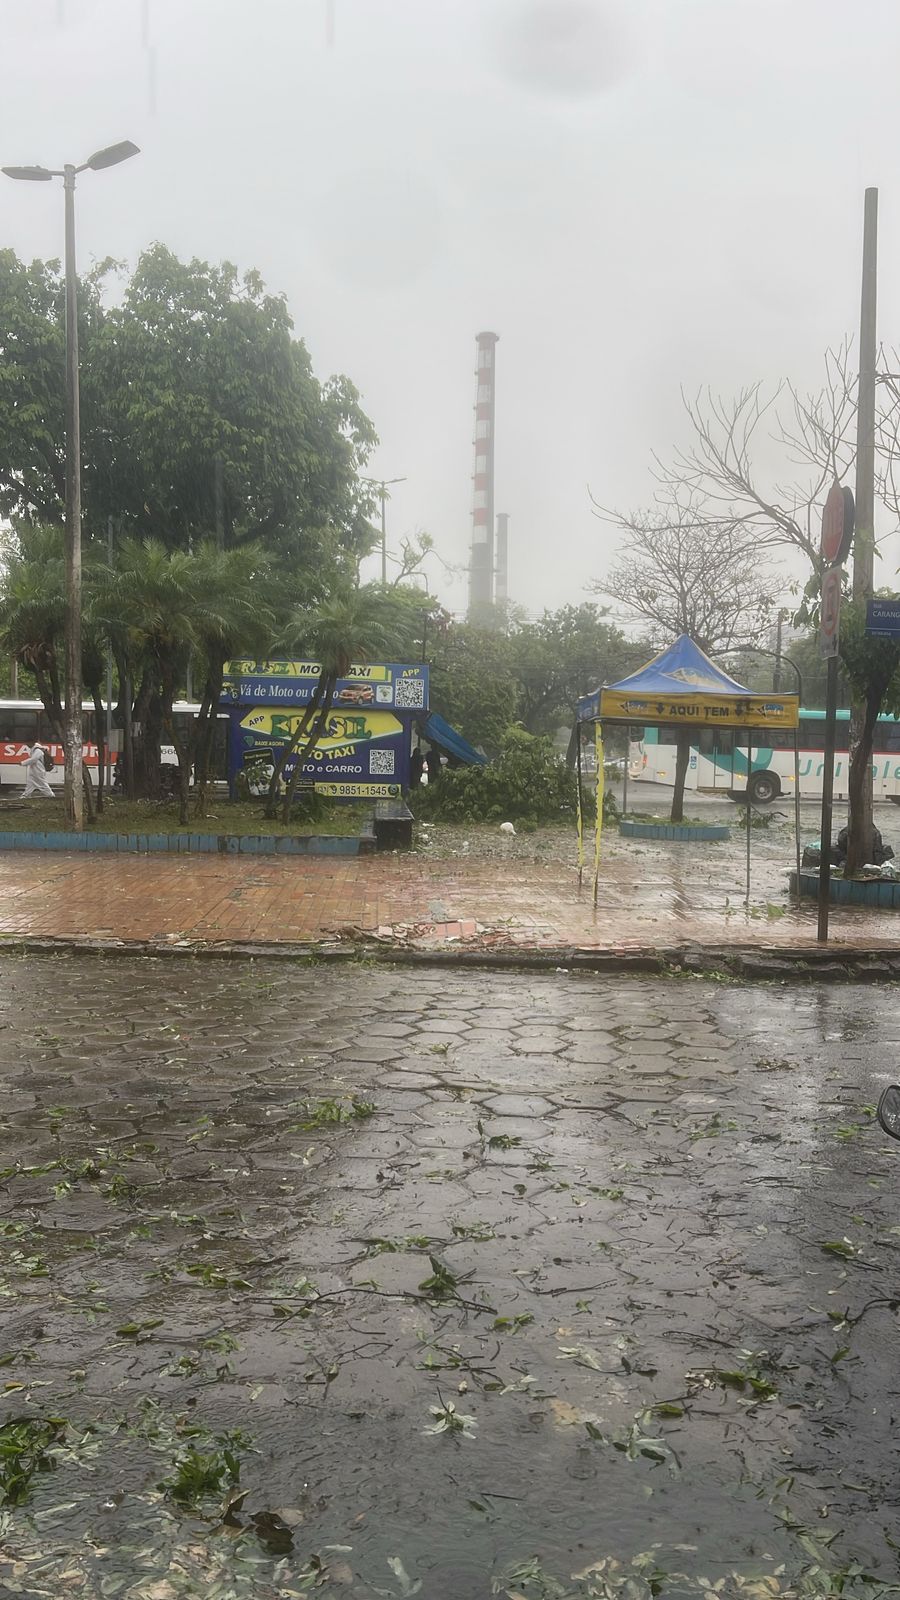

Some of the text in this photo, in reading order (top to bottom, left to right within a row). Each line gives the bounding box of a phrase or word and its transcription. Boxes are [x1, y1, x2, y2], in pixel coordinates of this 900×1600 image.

[299, 665, 321, 674] MO
[347, 667, 371, 677] AXI
[402, 668, 420, 677] APP
[240, 684, 252, 696] Vá
[254, 684, 266, 697] de
[268, 685, 294, 697] Moto
[295, 688, 309, 698] ou
[669, 704, 729, 718] AQUI TEM
[248, 715, 265, 727] APP
[4, 744, 99, 757] SAITUR
[325, 745, 356, 760] TAXI
[284, 763, 315, 773] MTO
[325, 764, 363, 773] CARRO
[339, 785, 387, 796] 9851-1545
